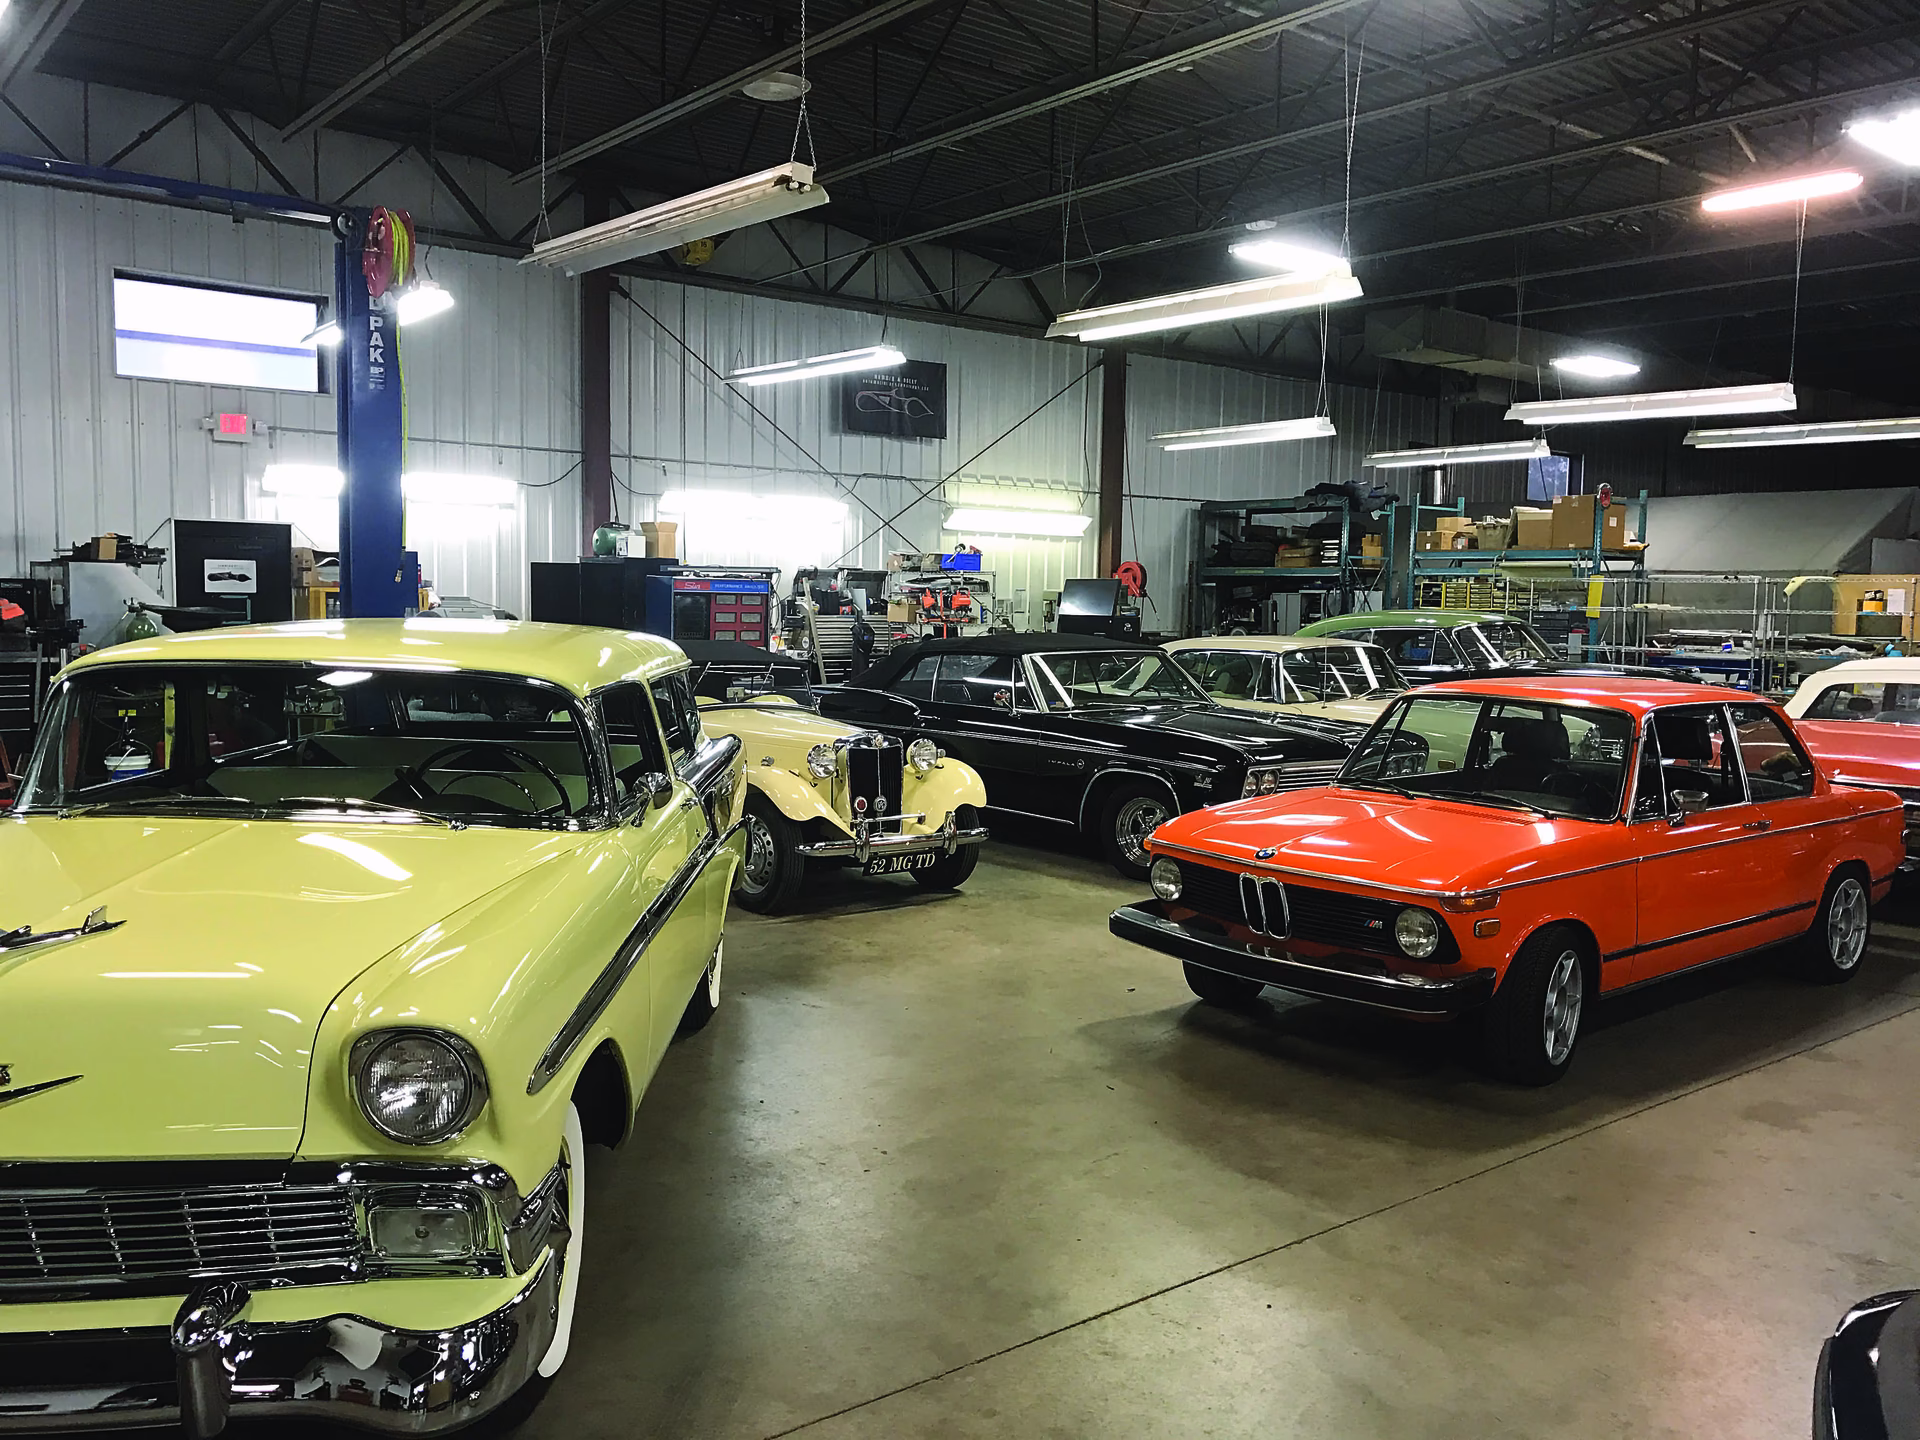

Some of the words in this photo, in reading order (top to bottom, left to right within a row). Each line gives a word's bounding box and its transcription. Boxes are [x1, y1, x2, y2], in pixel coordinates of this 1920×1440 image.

[869, 858, 887, 874] 52
[888, 855, 914, 872] MG
[915, 853, 936, 869] TD
